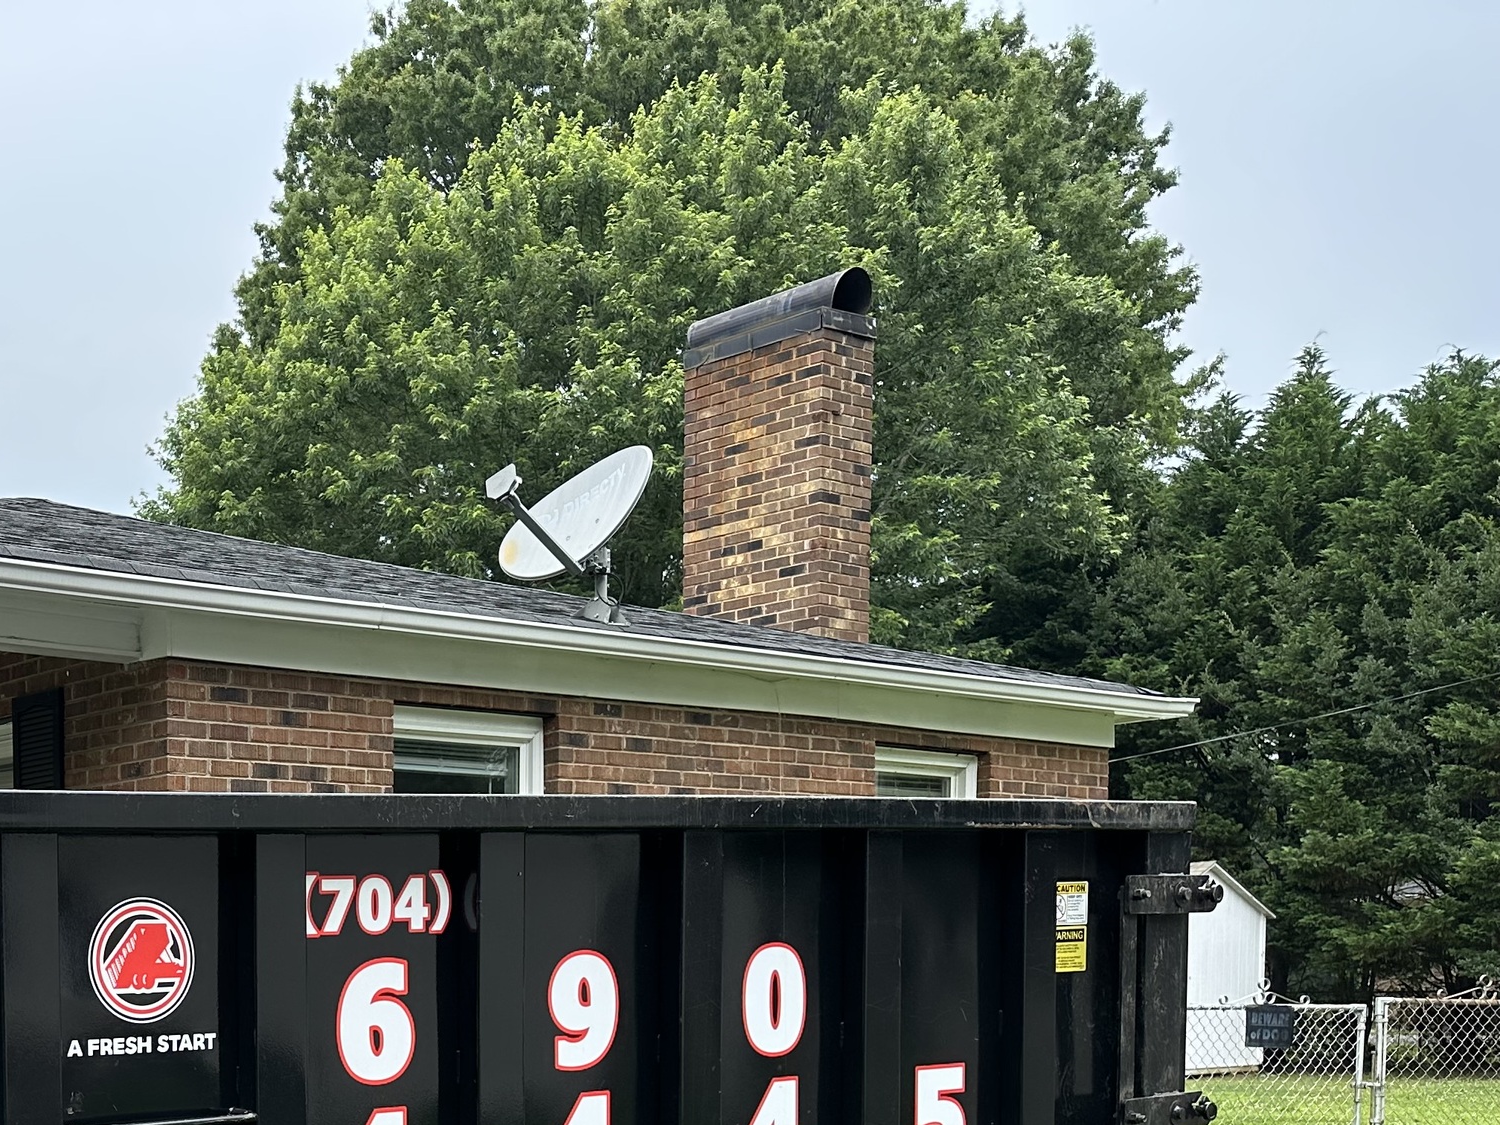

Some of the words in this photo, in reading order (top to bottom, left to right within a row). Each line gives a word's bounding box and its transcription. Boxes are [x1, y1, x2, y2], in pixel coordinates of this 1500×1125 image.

[562, 463, 626, 513] DIRECTV
[1056, 885, 1086, 893] CAUTION
[306, 869, 452, 939] (704)
[1056, 930, 1084, 941] ARNING
[335, 956, 417, 1086] 6
[547, 949, 620, 1072] 9
[741, 941, 807, 1058] 0
[1251, 1012, 1290, 1025] BEWARE
[1250, 1028, 1262, 1040] of
[66, 1039, 84, 1058] A
[87, 1035, 153, 1057] FRESH
[156, 1032, 217, 1053] START
